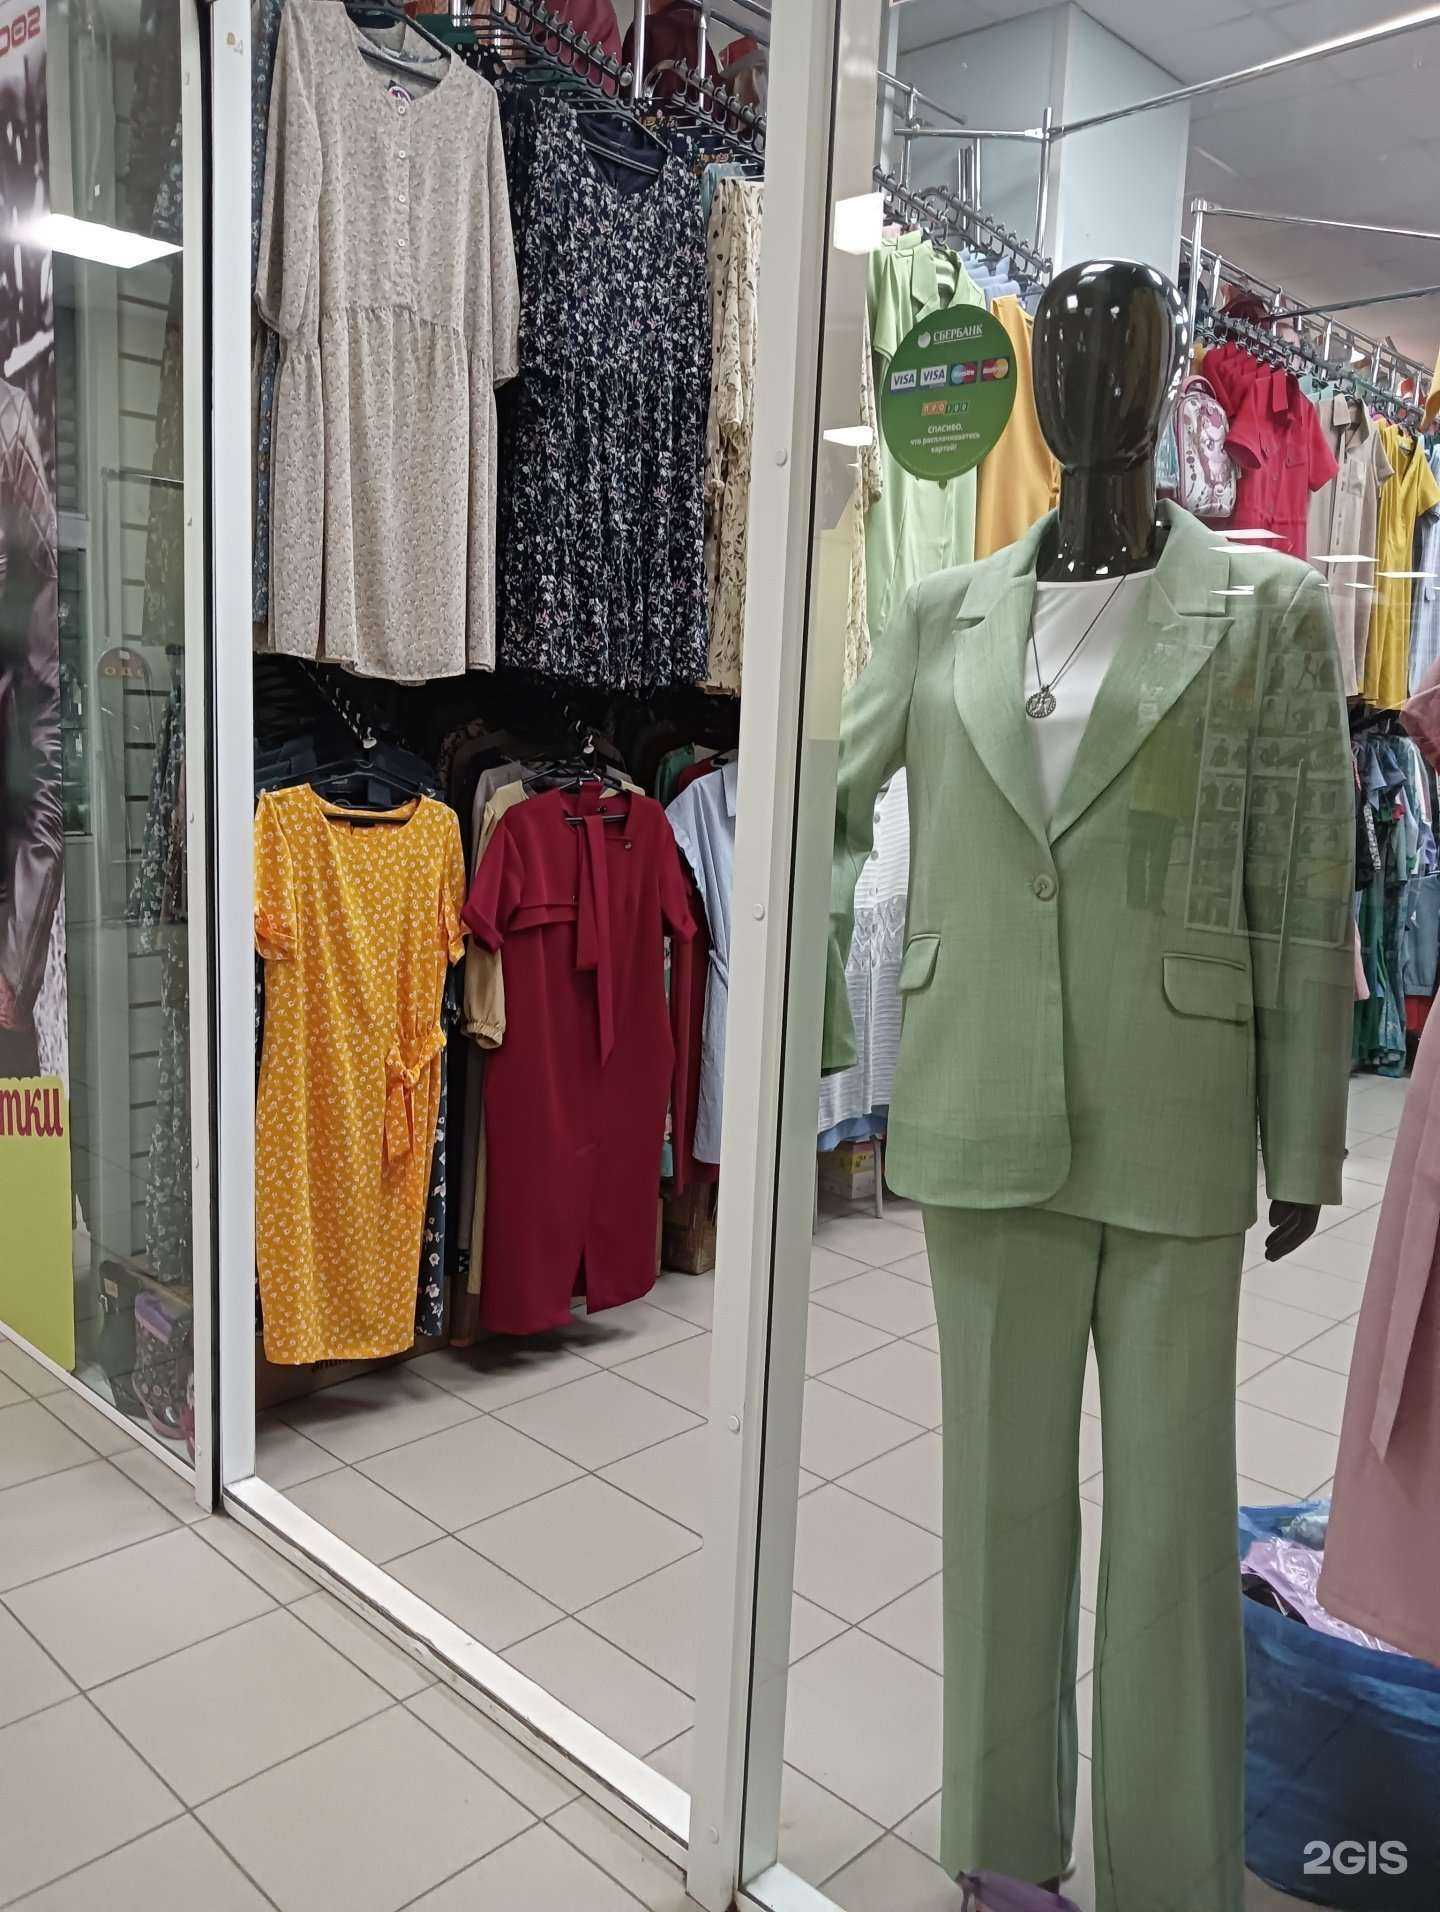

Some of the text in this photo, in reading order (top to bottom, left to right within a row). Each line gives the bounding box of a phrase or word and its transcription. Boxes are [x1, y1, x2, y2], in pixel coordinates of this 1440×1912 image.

[933, 323, 983, 341] СБЕРБАНК
[894, 373, 915, 386] VISA
[923, 368, 945, 381] VISA
